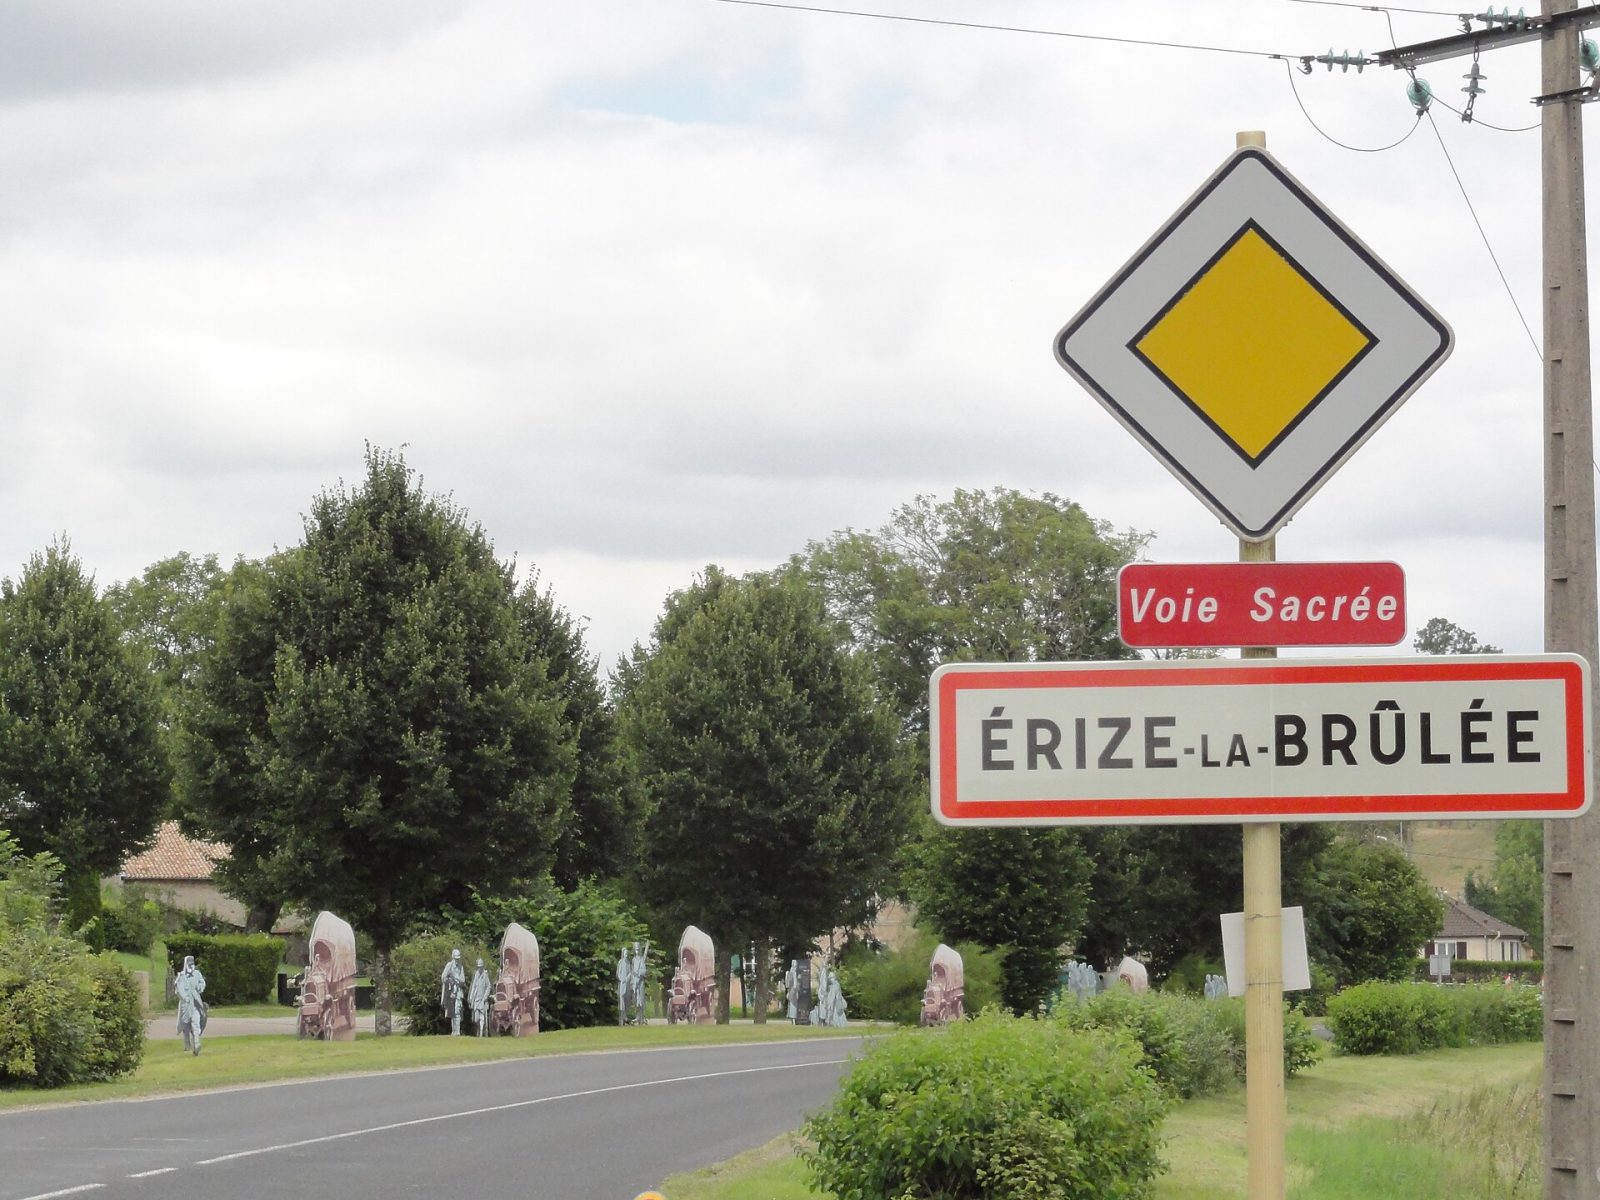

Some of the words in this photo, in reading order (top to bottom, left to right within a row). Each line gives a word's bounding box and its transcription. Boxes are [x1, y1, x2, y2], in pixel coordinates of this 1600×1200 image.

[1130, 587, 1218, 623] Voie
[1249, 586, 1397, 622] Sacrée
[982, 698, 1541, 771] ÉRIZE-LA-BRÛLÉE
